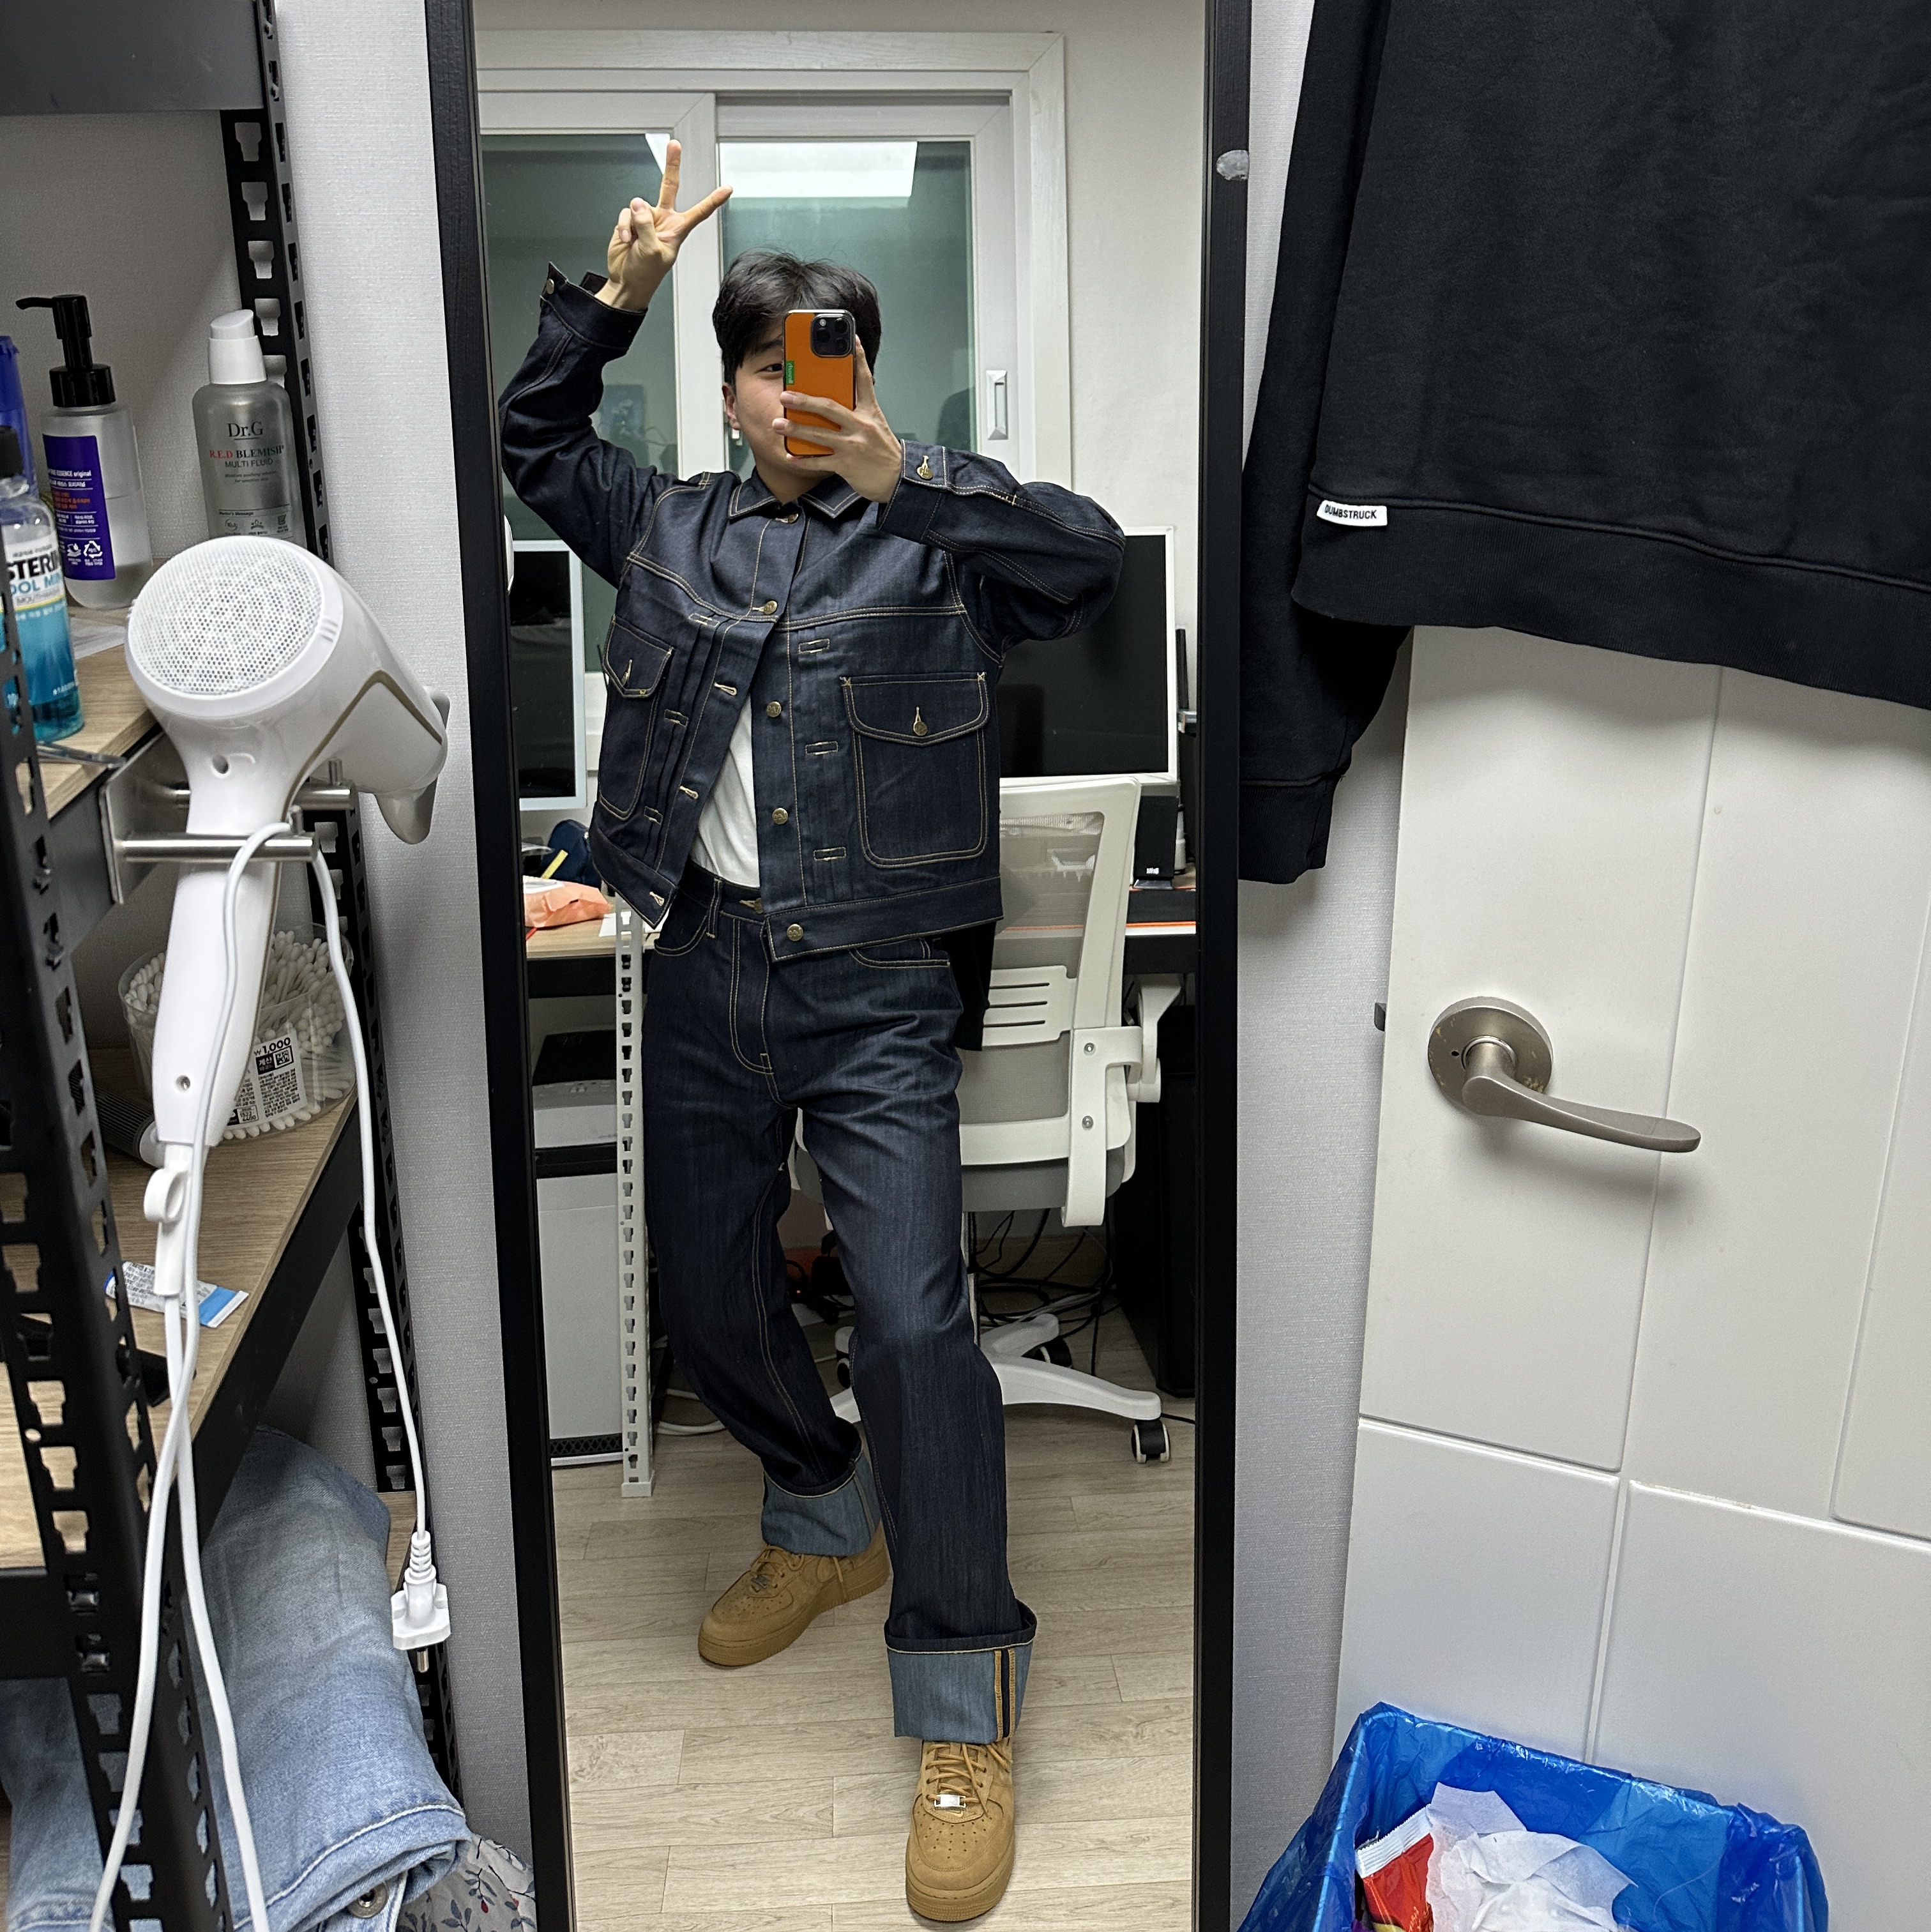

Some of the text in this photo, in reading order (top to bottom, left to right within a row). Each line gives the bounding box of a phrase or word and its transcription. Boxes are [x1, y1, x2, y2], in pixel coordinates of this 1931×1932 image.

[227, 422, 264, 437] Dr.G
[209, 449, 234, 459] R.E.D
[225, 458, 273, 468] MULTI FLUID
[1324, 504, 1377, 519] DUMBSTRUCK
[259, 1056, 273, 1067] 계산
